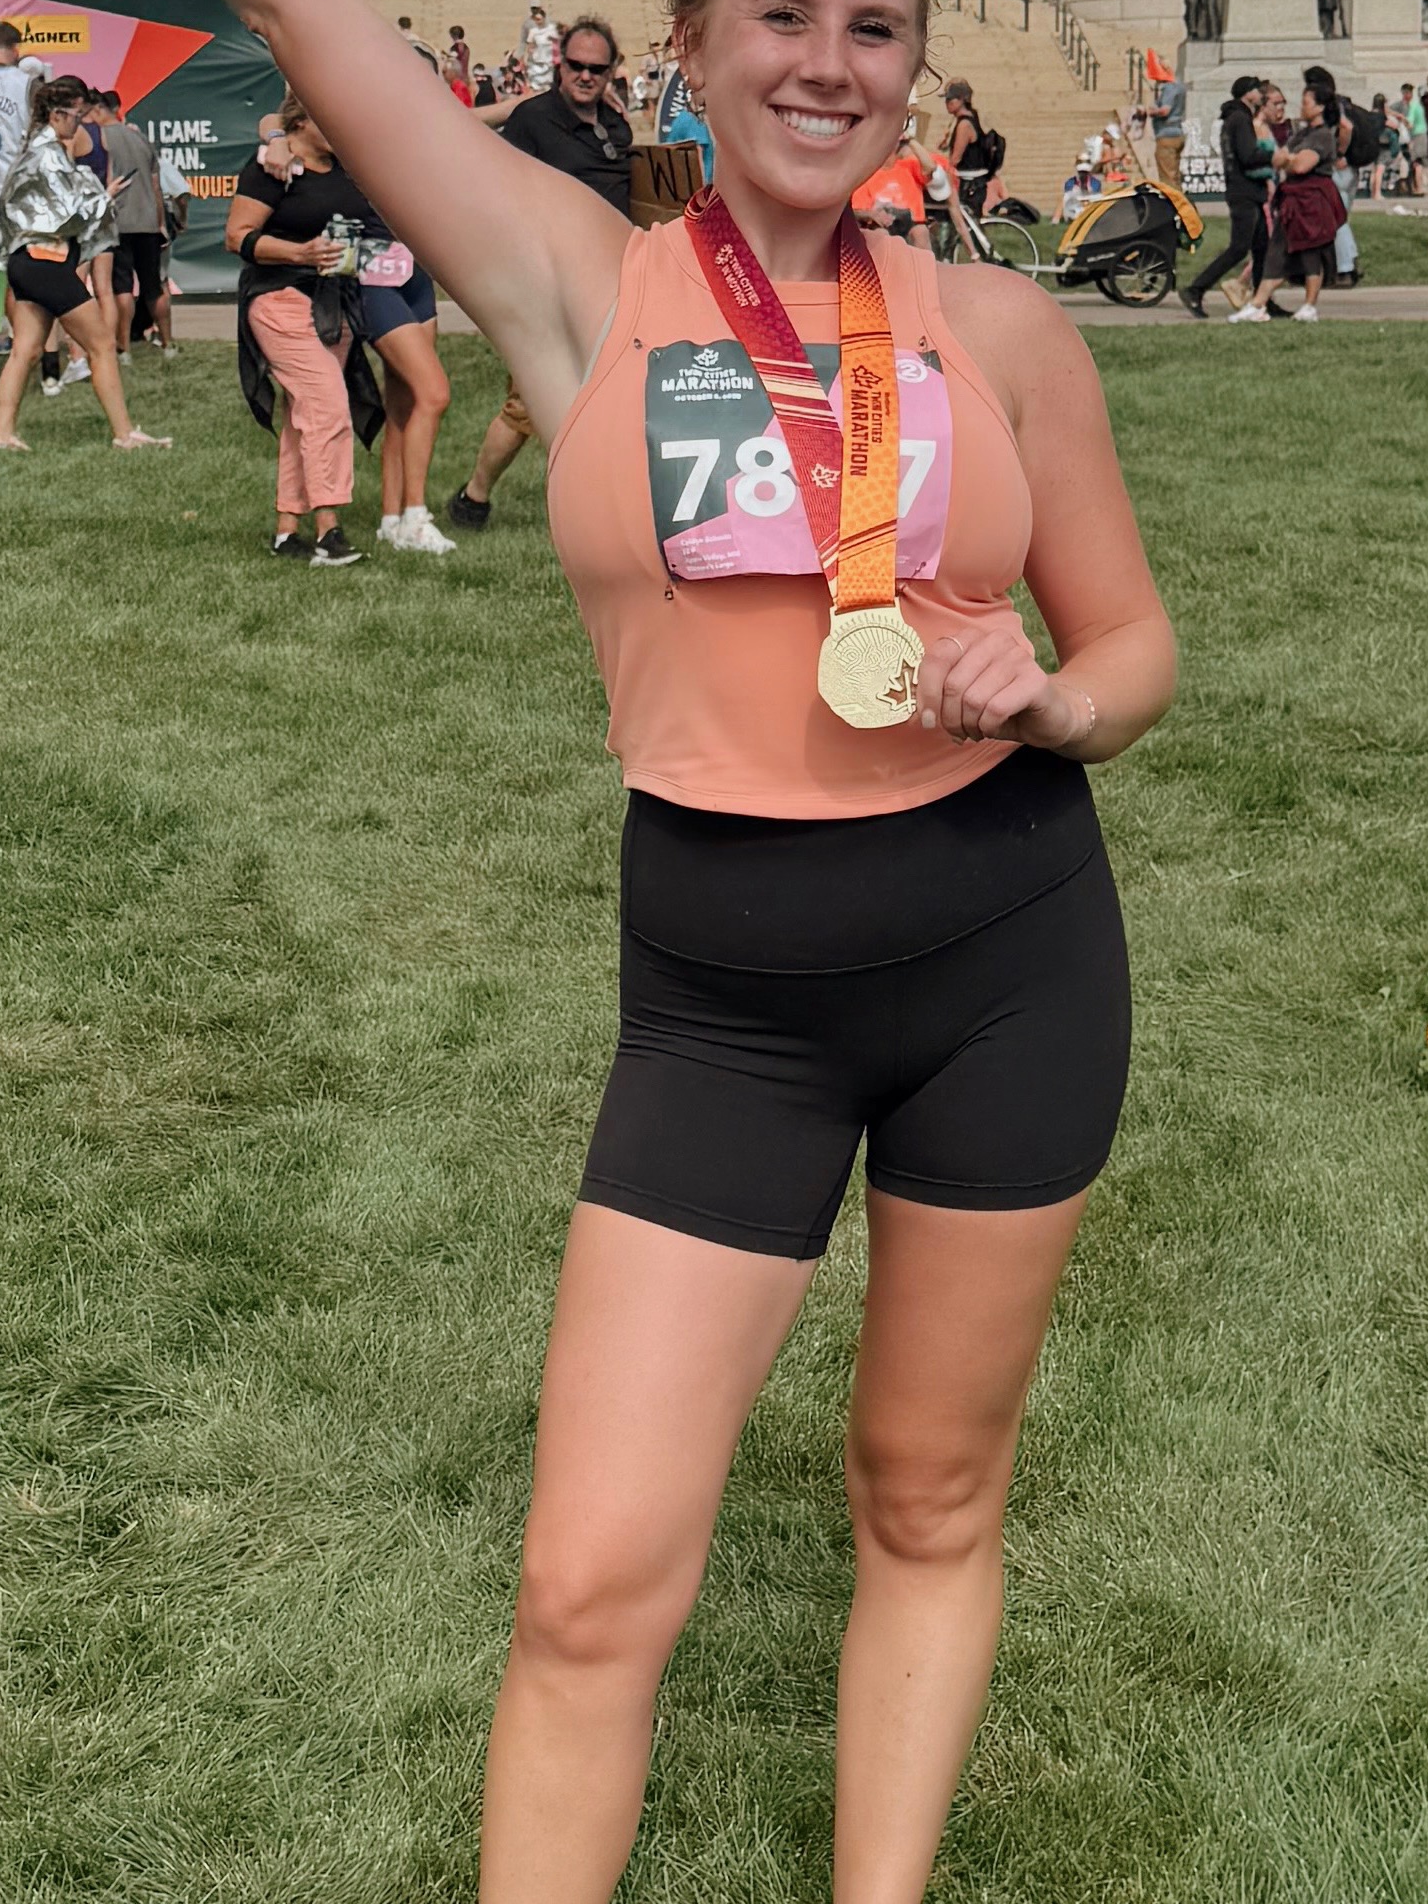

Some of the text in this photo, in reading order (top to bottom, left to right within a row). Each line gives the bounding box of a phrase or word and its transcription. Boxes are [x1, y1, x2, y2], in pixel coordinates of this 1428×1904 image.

[22, 22, 80, 43] AGNER
[148, 120, 219, 144] I CAME.
[661, 376, 754, 392] MARATHON
[849, 389, 869, 476] MARATHON
[871, 413, 883, 444] CITIES
[661, 436, 937, 522] 787
